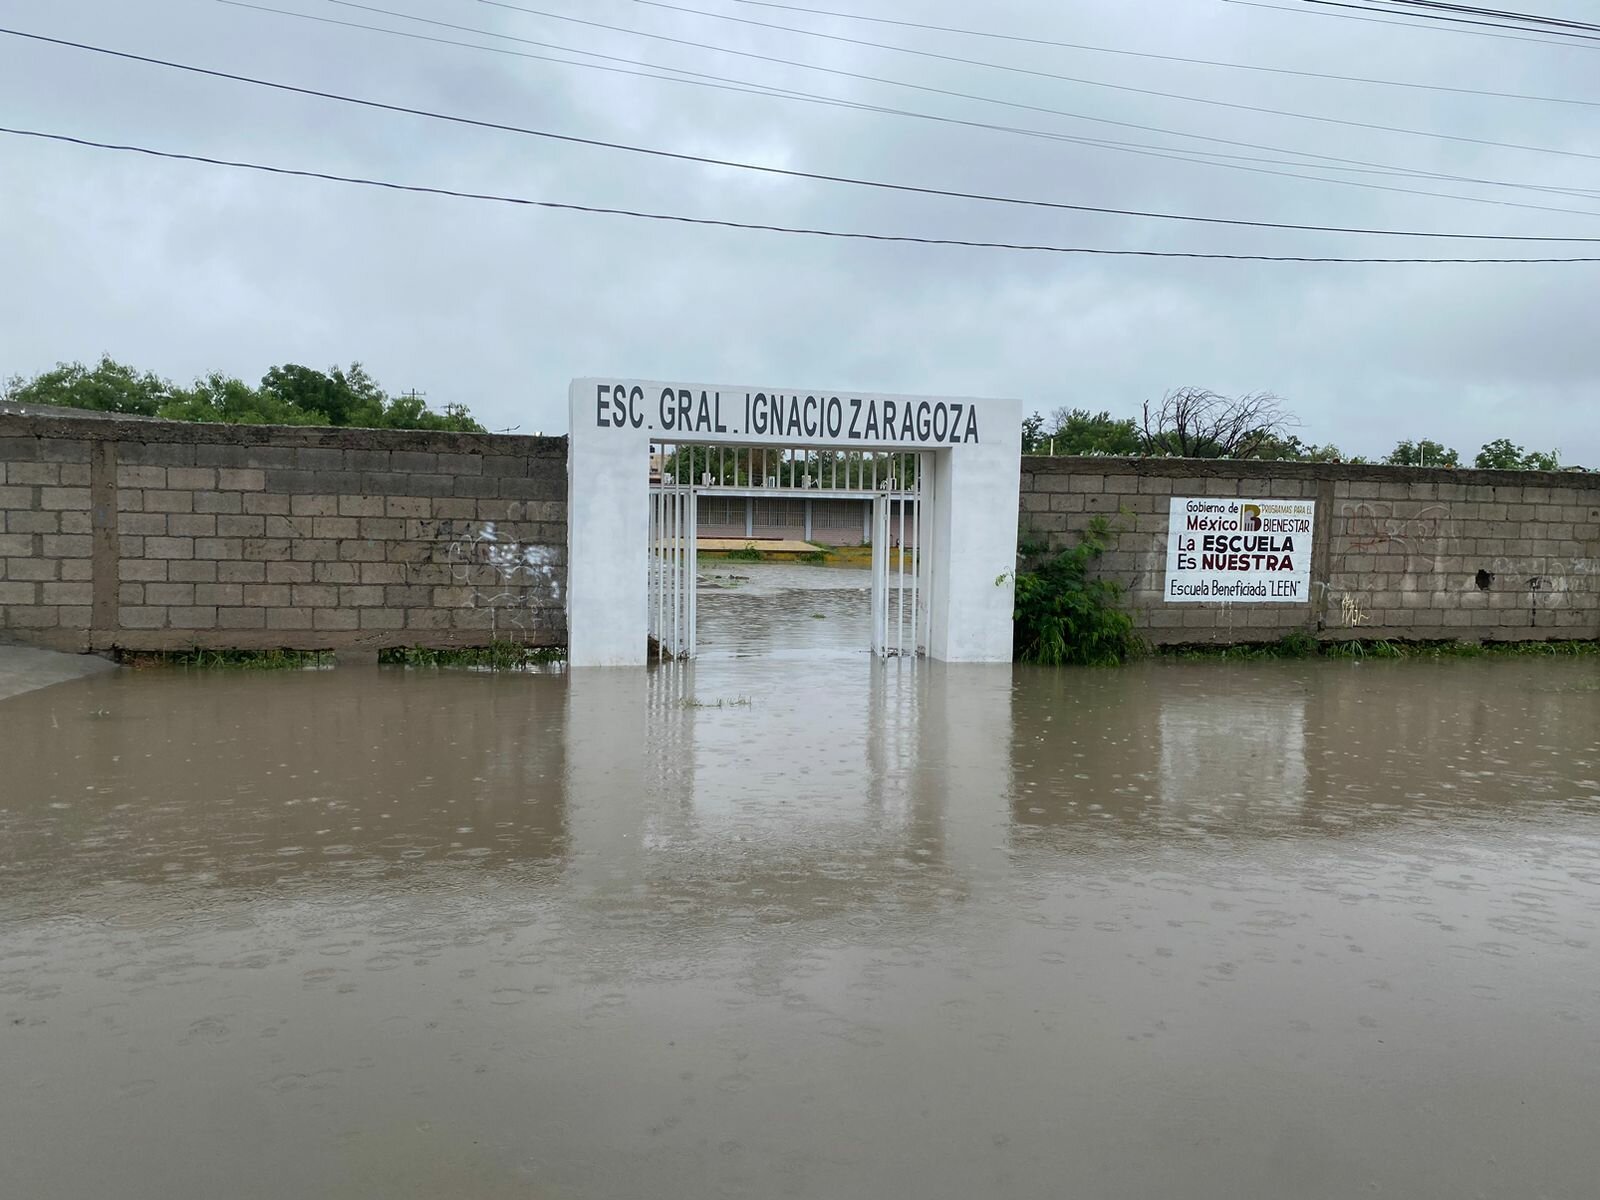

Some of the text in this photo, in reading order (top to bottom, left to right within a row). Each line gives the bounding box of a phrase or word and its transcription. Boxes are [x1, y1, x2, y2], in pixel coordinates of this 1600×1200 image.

[596, 384, 980, 444] ESC. GRAL. IGNACIO ZARAGOZA
[1186, 500, 1239, 514] Gobierno de
[1186, 515, 1238, 531] México
[1263, 518, 1310, 533] BIENESTAR
[1178, 535, 1294, 553] La ESCUELA
[1177, 553, 1294, 571] Es NUESTRA
[1171, 579, 1209, 596] Escuela
[1211, 580, 1267, 597] Beneficiada
